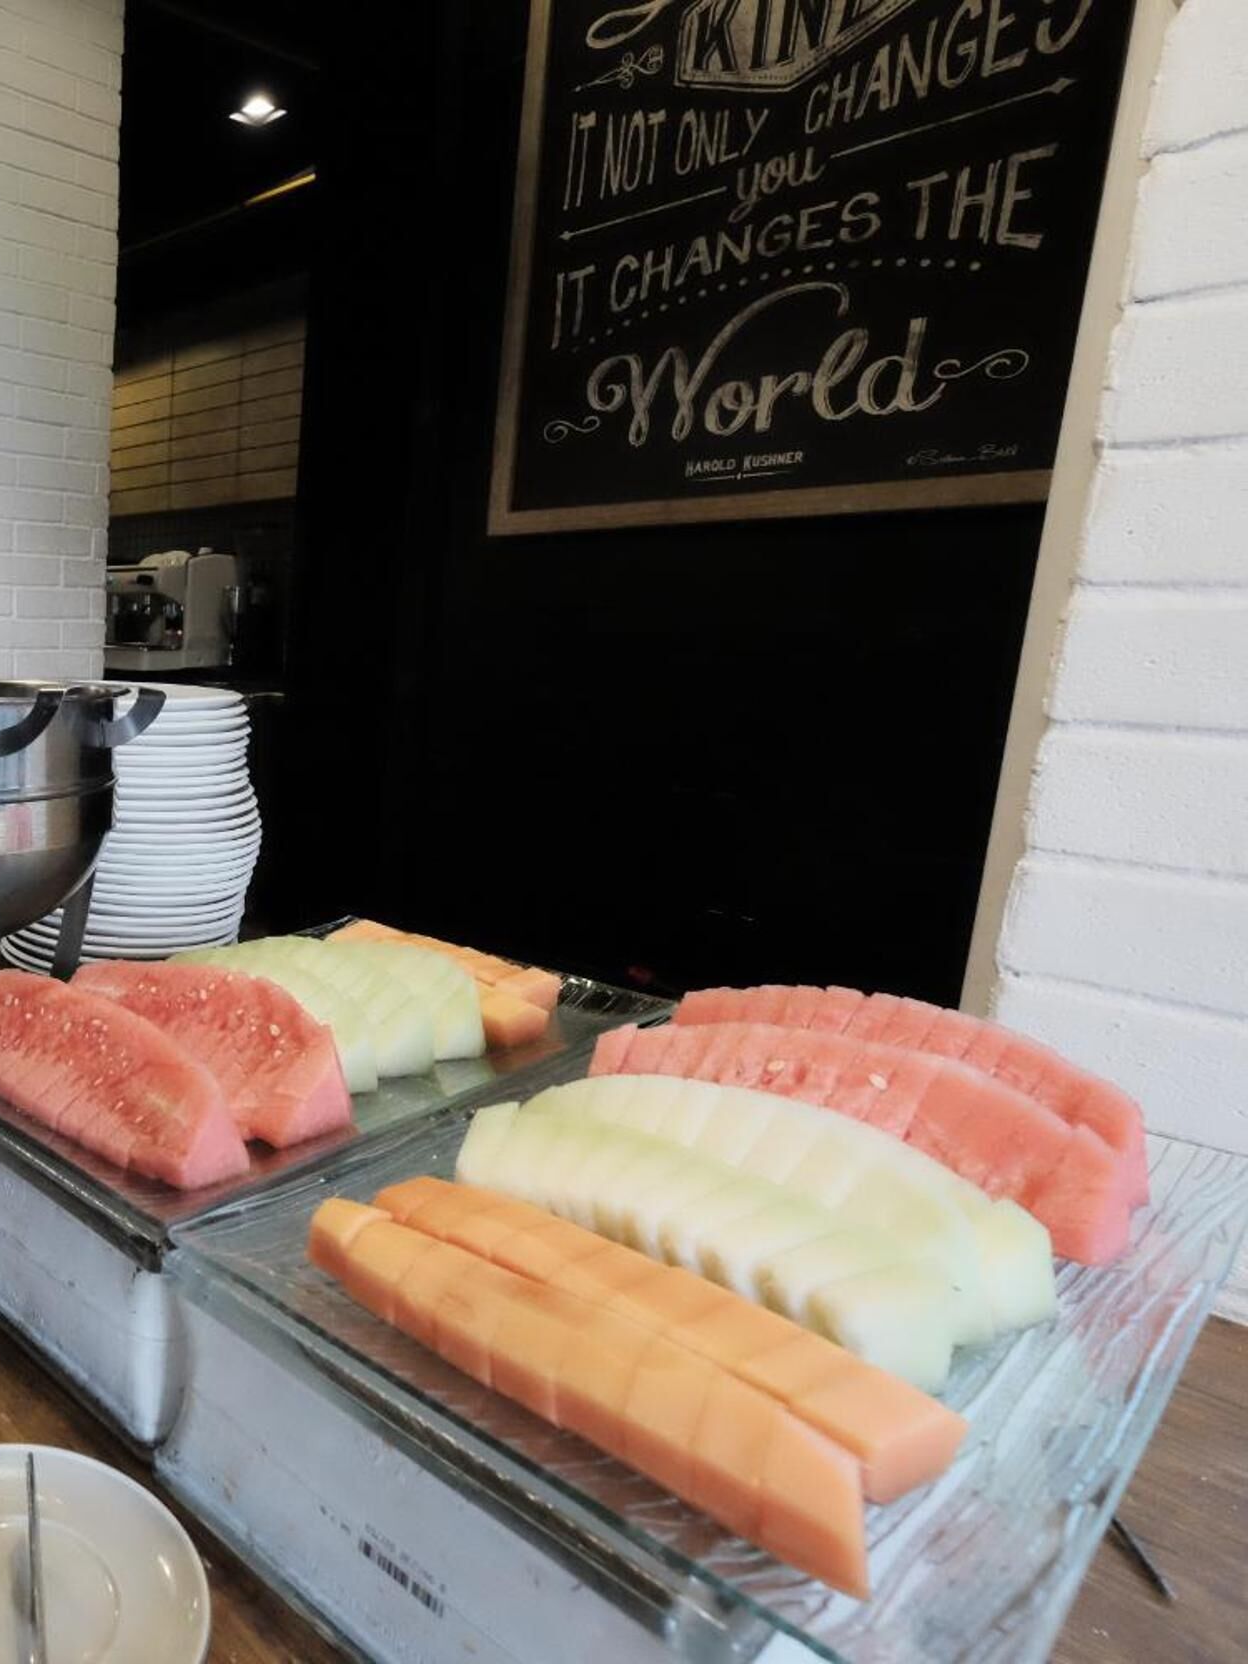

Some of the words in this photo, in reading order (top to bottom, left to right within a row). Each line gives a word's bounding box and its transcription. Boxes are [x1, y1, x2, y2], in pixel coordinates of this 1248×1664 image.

[563, 110, 597, 210] IT
[600, 109, 667, 200] NOT
[674, 108, 770, 176] ONLY
[728, 146, 826, 222] you
[551, 264, 596, 350] IT
[610, 191, 882, 313] CHANGES
[906, 142, 1059, 250] THE
[586, 281, 948, 447] World
[684, 457, 737, 479] HAROLD
[742, 451, 804, 472] KUSHNER
